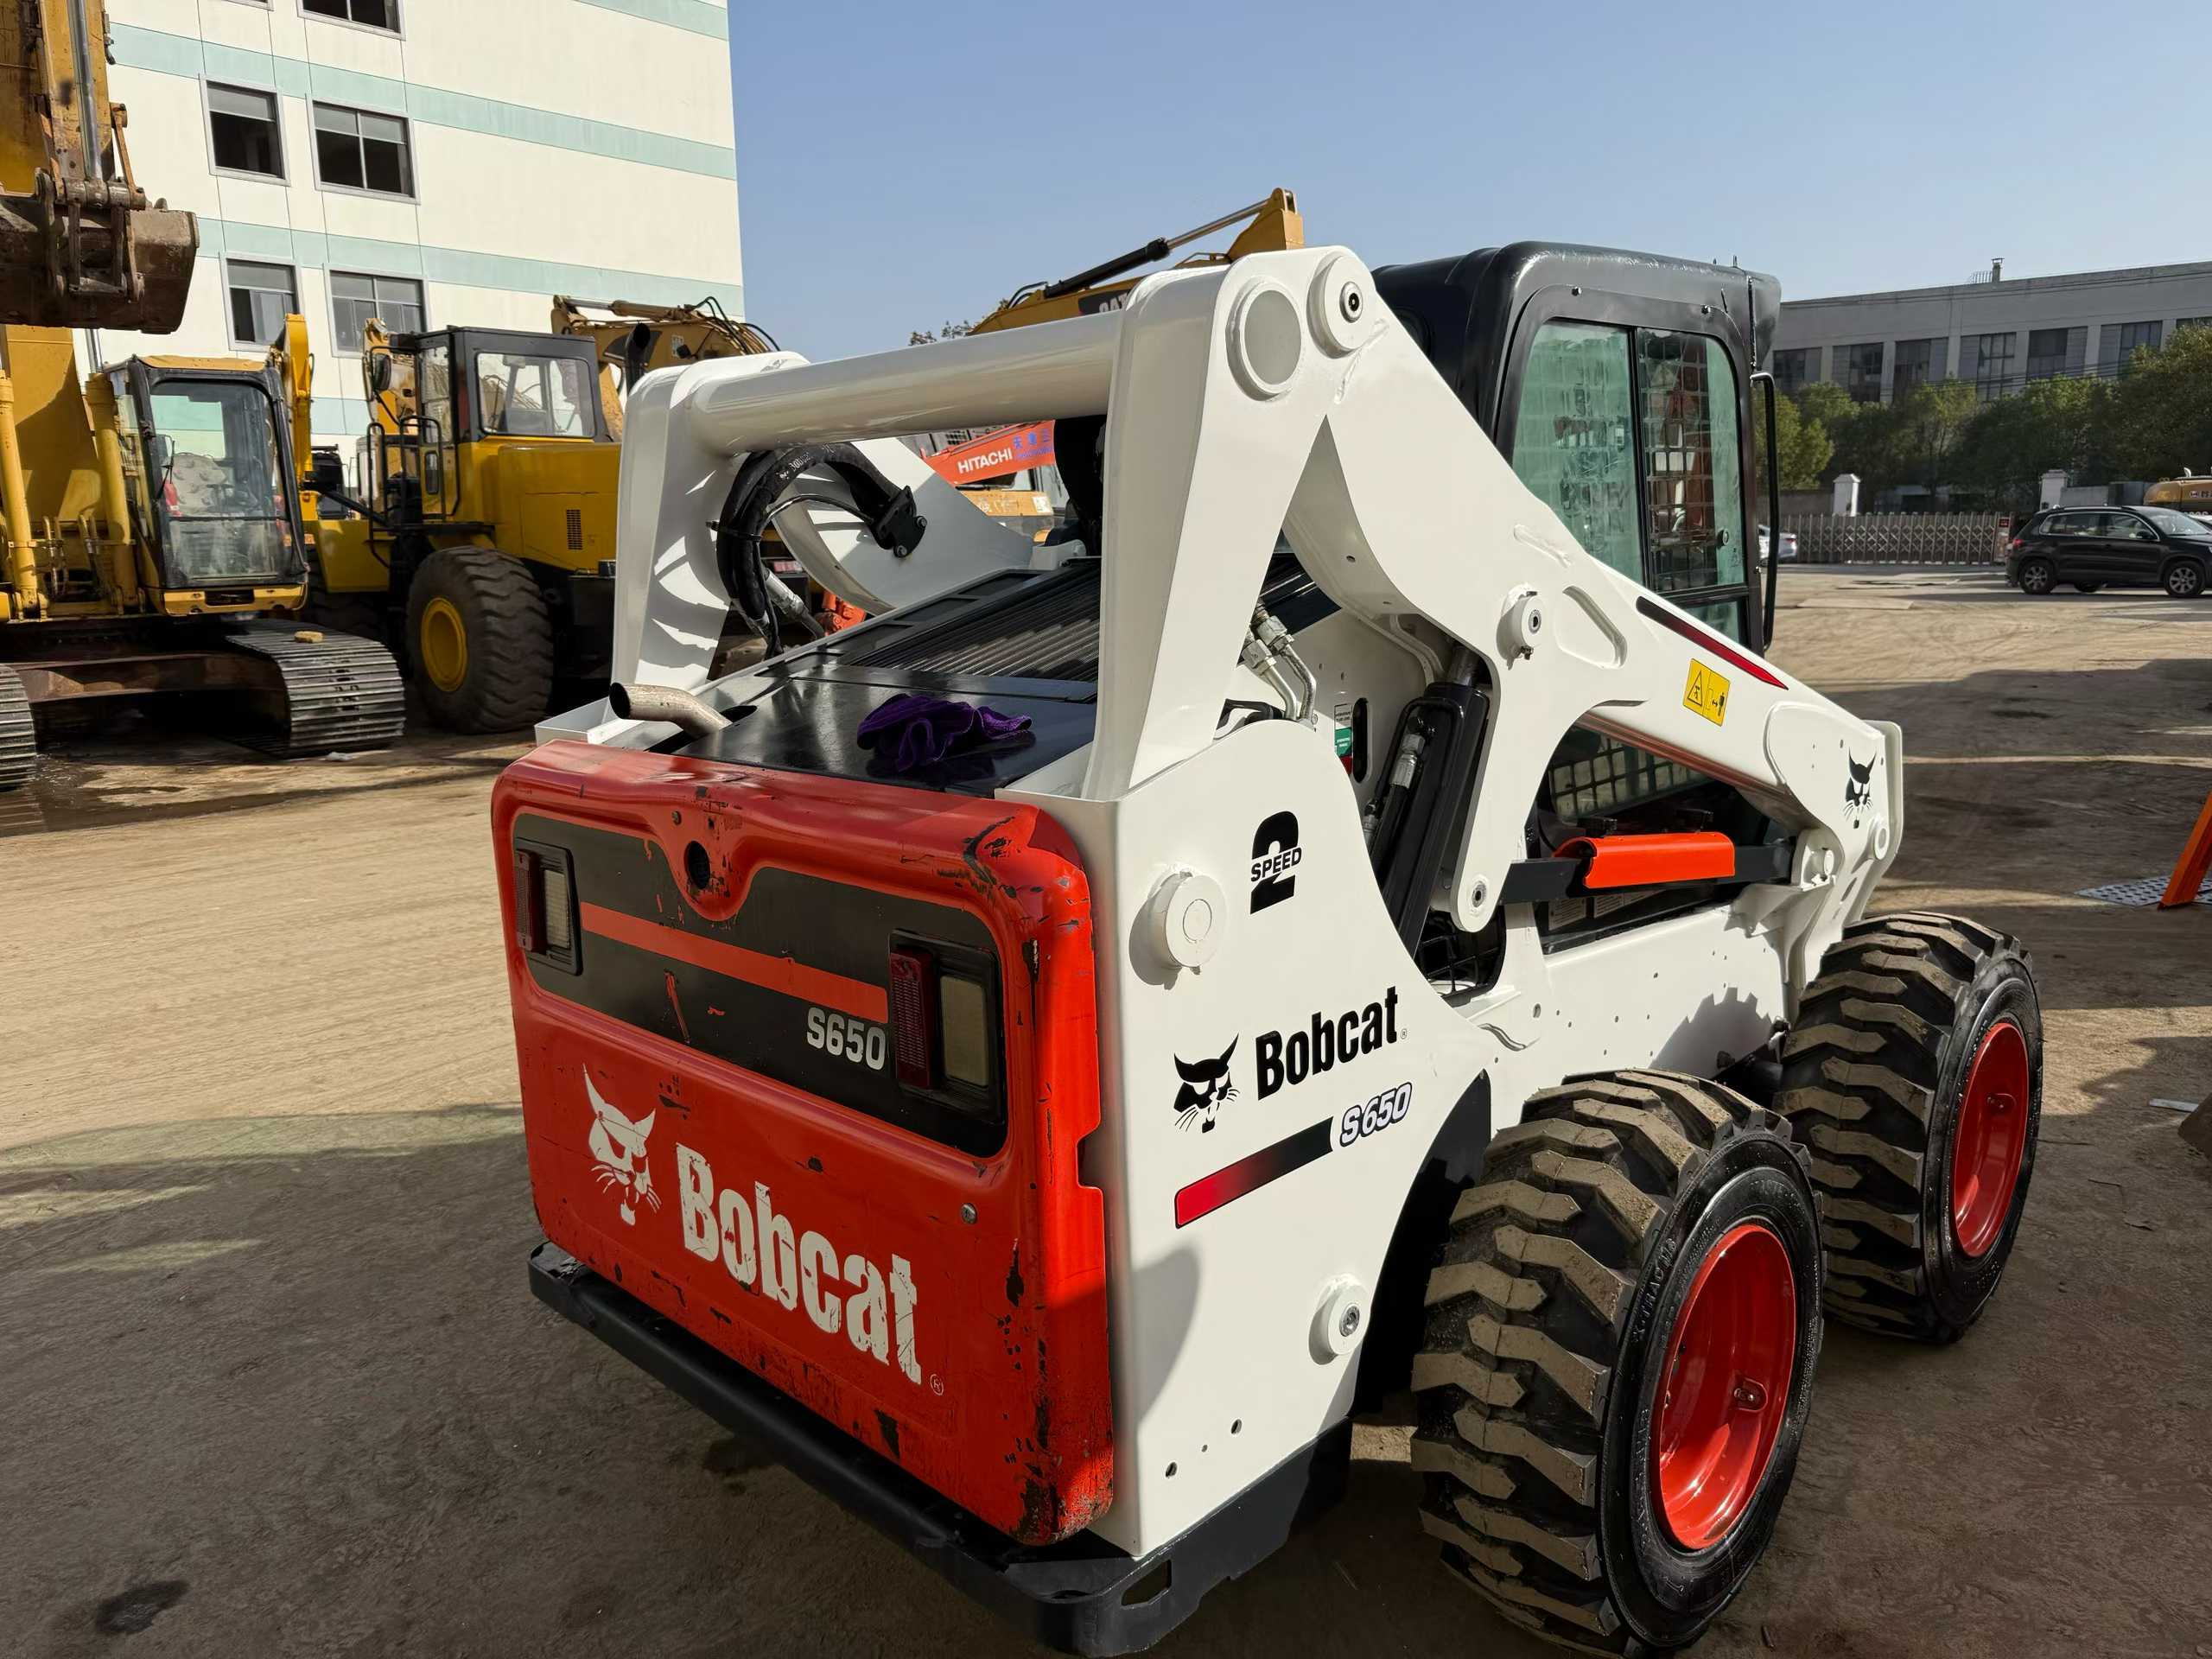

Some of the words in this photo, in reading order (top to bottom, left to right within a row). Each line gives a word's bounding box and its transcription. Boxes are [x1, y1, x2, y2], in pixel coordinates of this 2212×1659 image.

[957, 447, 1013, 474] HITACHI
[1250, 847, 1302, 882] SPEED
[806, 1007, 886, 1071] S650
[1255, 986, 1398, 1101] Bobcat
[1339, 1081, 1413, 1147] S650
[676, 1141, 922, 1385] Bobcat
